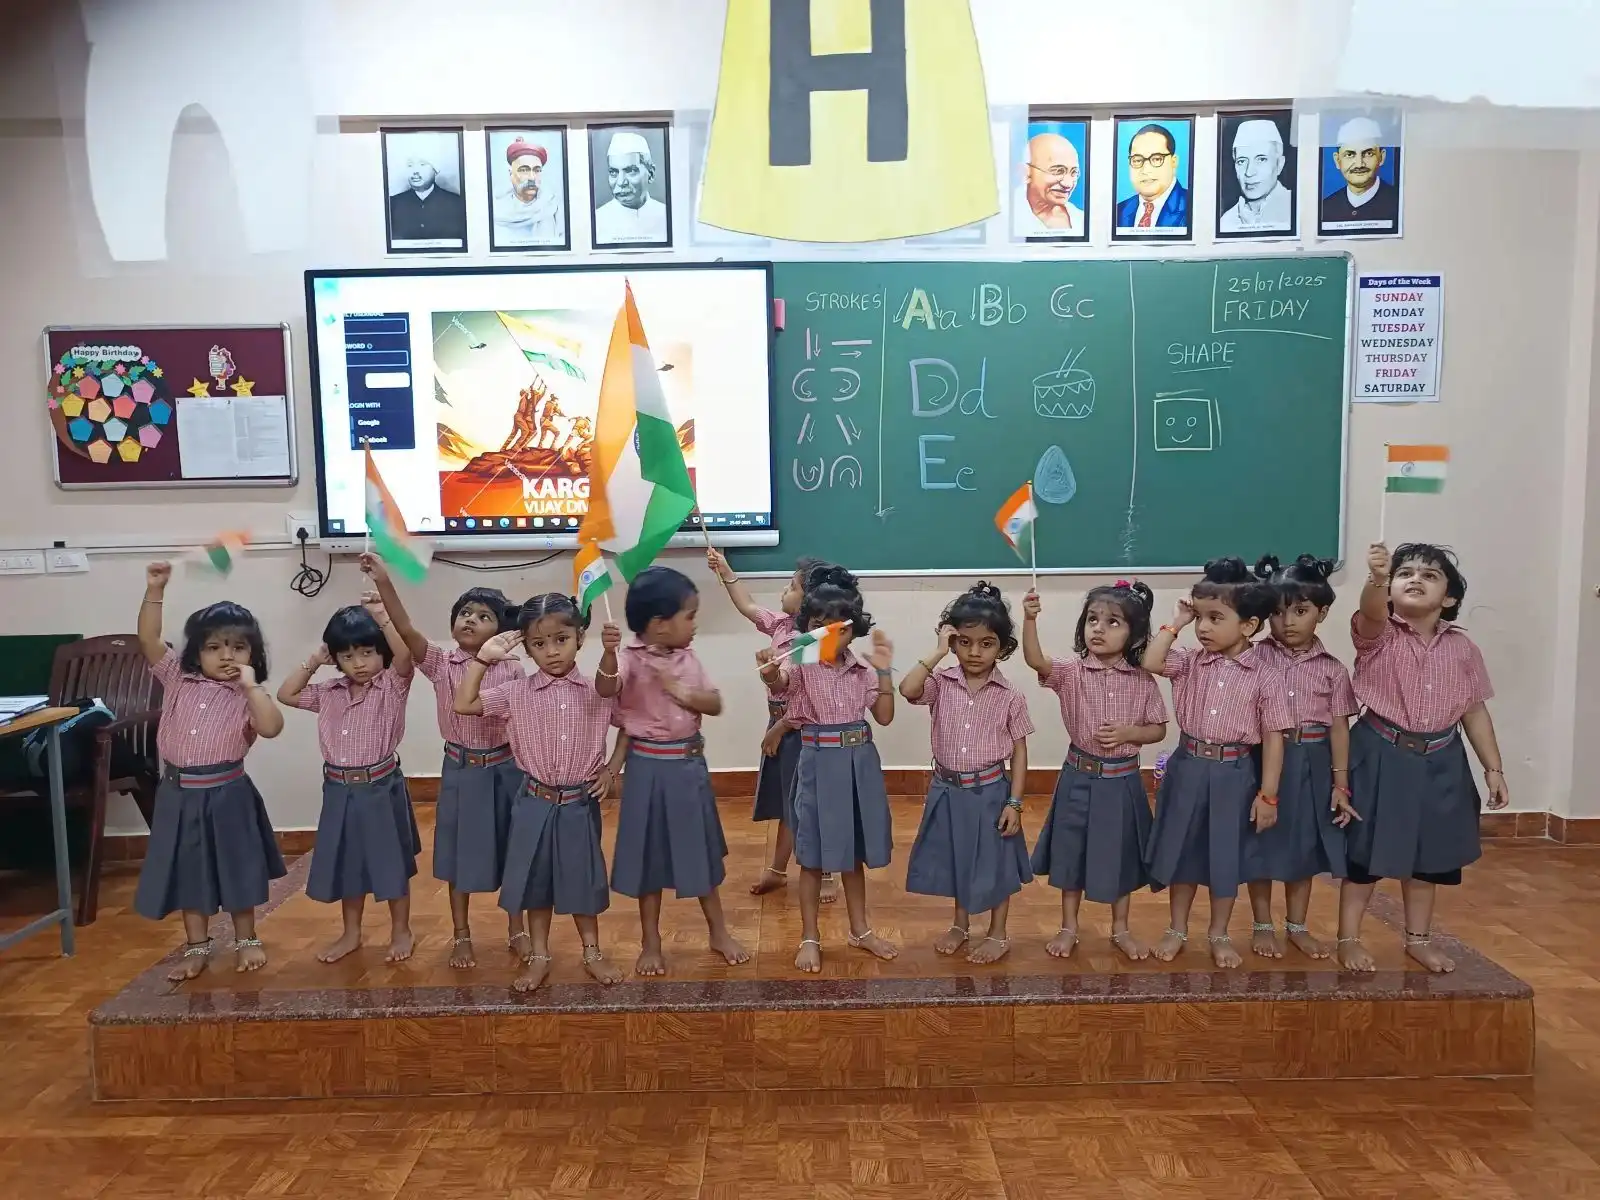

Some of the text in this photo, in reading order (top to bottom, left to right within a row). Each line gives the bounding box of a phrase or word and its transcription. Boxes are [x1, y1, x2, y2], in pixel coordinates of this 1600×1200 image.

[769, 0, 908, 166] H
[1228, 272, 1327, 294] 25/07/2025
[1368, 279, 1387, 288] Days
[1387, 277, 1397, 285] of
[1398, 277, 1410, 285] the
[805, 291, 882, 312] STROKES
[1375, 293, 1424, 303] SUNDAY
[1223, 299, 1310, 322] FRIDAY
[1373, 308, 1425, 318] MONDAY
[1371, 323, 1426, 333] TUESDAY
[1361, 338, 1434, 348] WEDNESDAY
[74, 349, 139, 357] Happy Birthday
[1167, 341, 1237, 365] SHAPE
[1365, 353, 1428, 363] THURSDAY
[1375, 368, 1417, 378] FRIDAY
[1364, 383, 1426, 393] SATURDAY
[357, 419, 380, 427] Google
